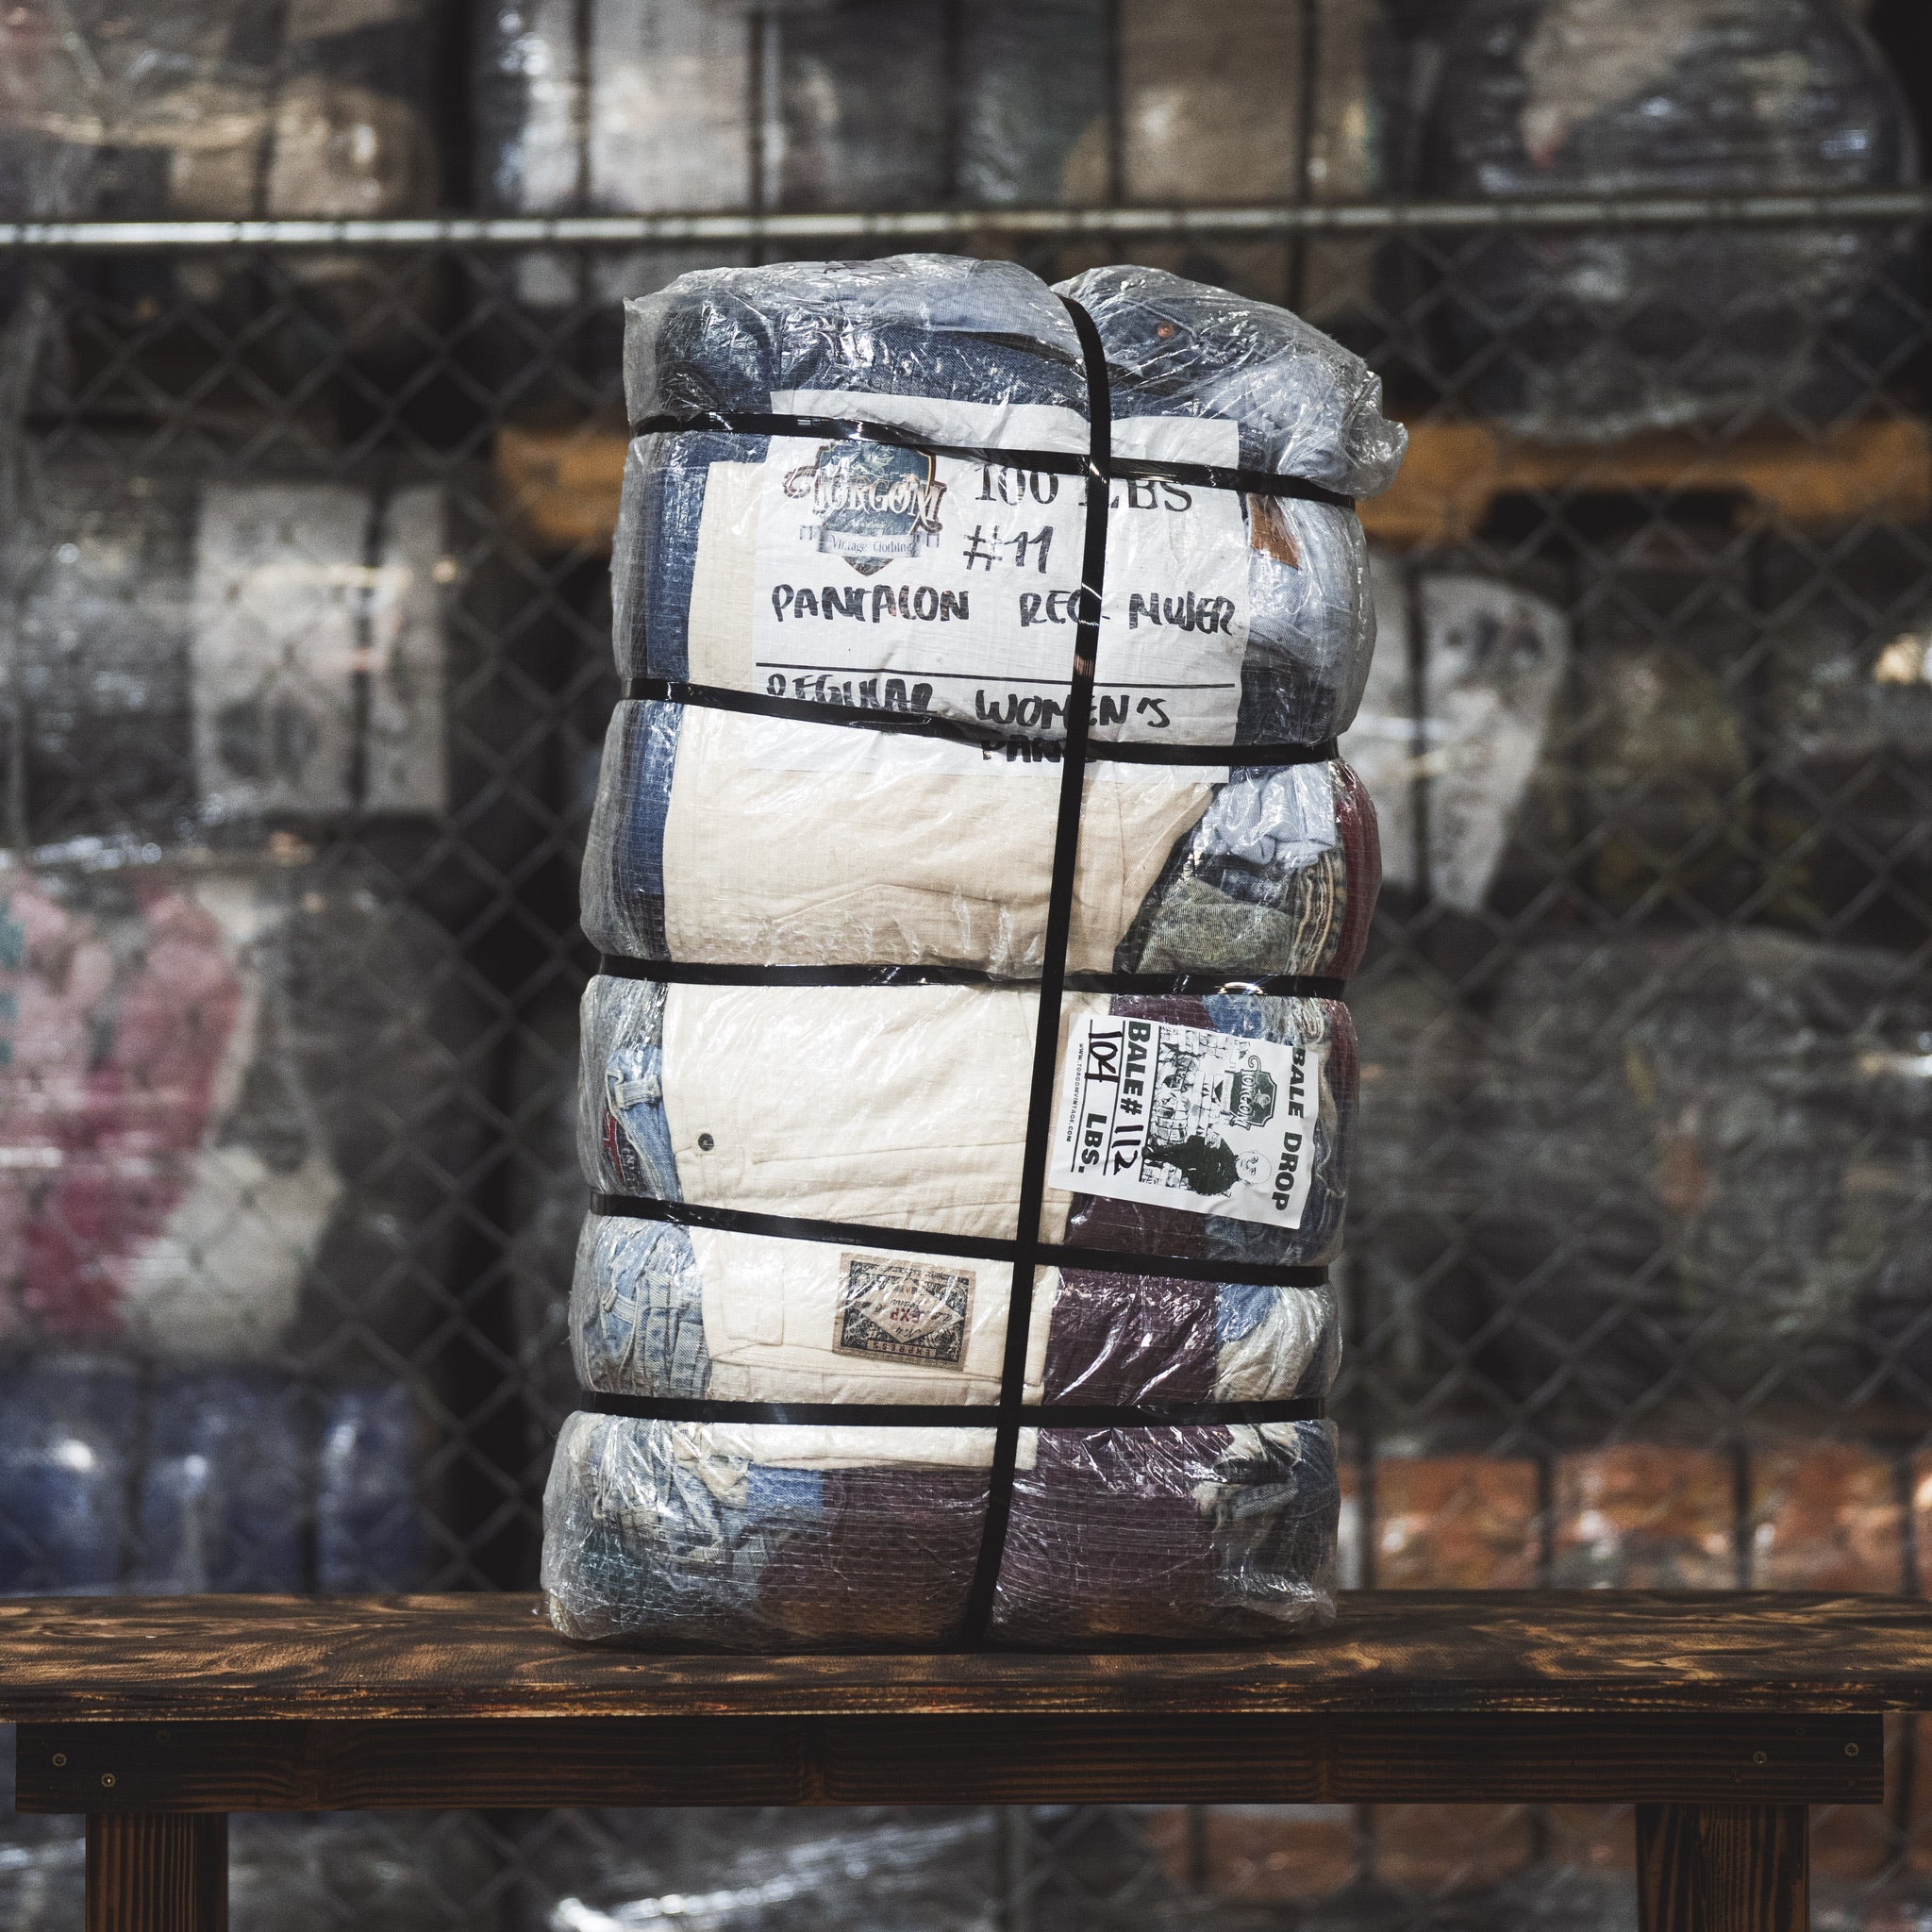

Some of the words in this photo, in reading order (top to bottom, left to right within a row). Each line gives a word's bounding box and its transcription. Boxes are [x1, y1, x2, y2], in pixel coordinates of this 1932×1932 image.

[974, 464, 1059, 506] 100
[1078, 475, 1192, 512] BS
[962, 525, 1055, 575] #11
[772, 584, 970, 624] PANTALON
[981, 734, 1097, 763] PAN
[1085, 1031, 1124, 1083] 104
[1120, 1021, 1151, 1116] BALE#
[1288, 1046, 1306, 1119] BALE
[1229, 1055, 1262, 1131] TORGOM
[1077, 1112, 1108, 1174] LBS.
[1111, 1124, 1144, 1176] 112
[1272, 1132, 1303, 1211] DROP
[873, 1341, 932, 1357] EXPRESS
